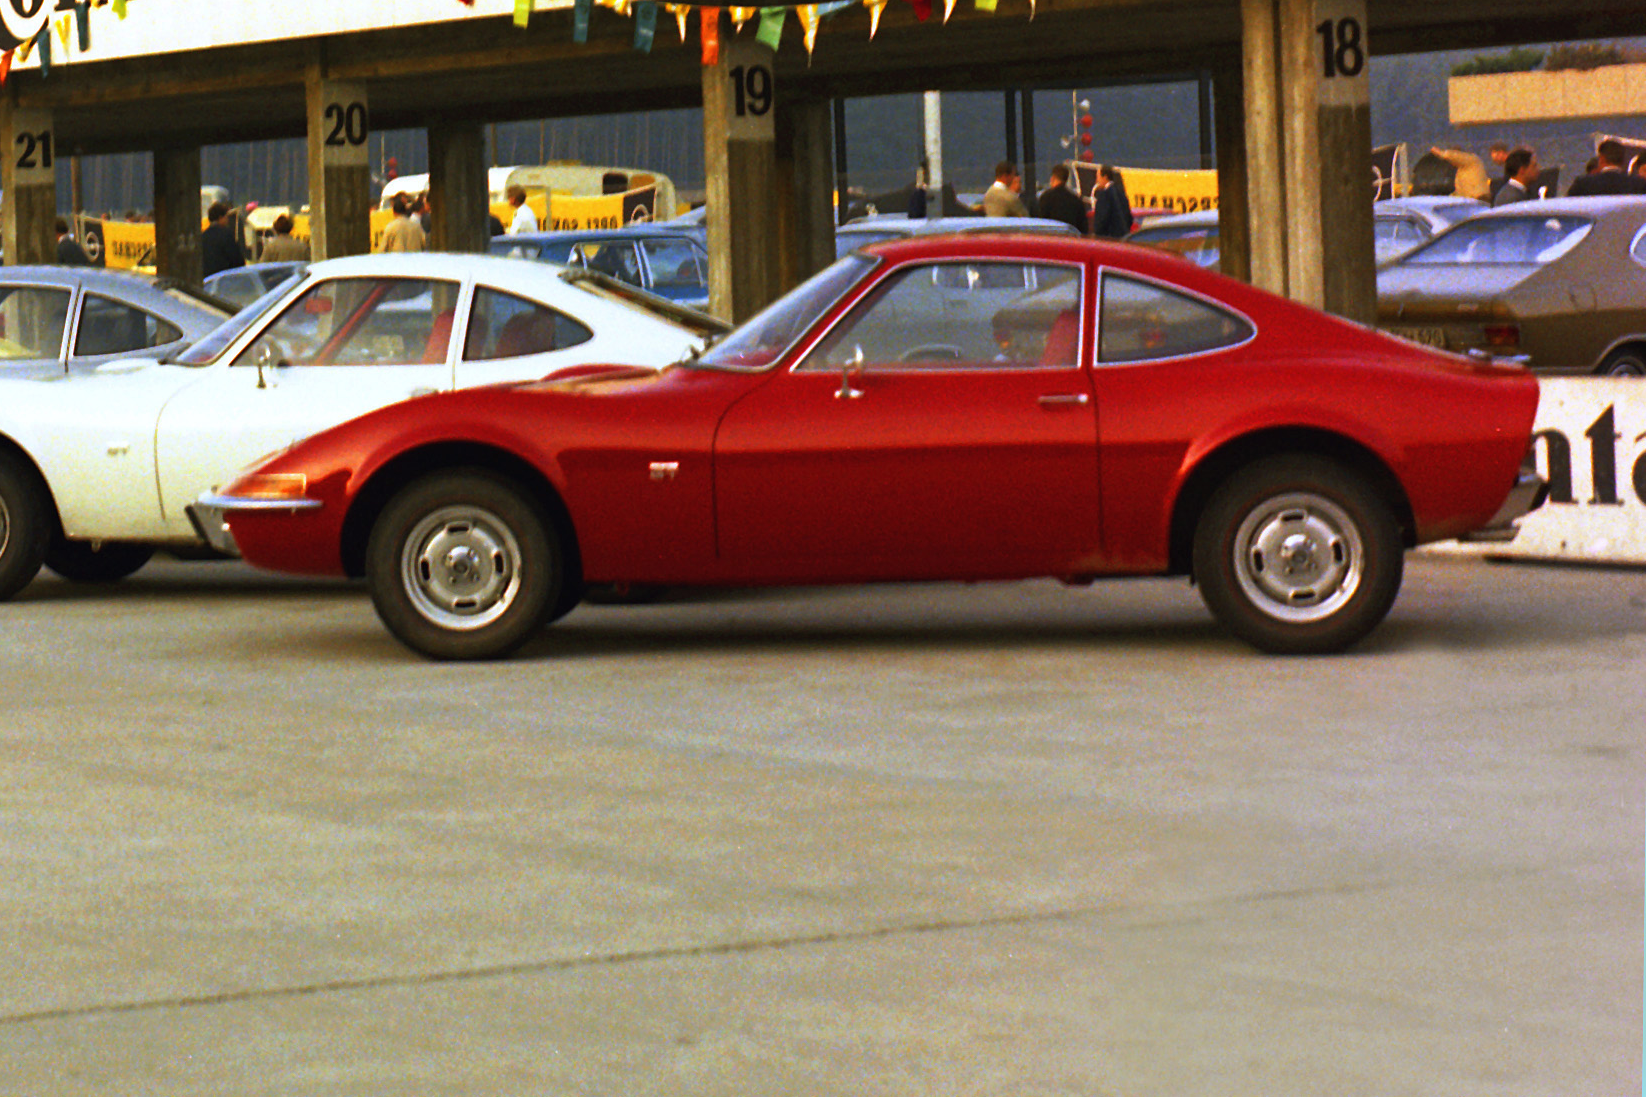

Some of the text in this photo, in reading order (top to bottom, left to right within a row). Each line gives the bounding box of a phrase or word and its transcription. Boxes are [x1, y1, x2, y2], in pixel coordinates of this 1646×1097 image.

[1316, 16, 1364, 79] 18
[729, 65, 772, 116] 19
[16, 130, 52, 168] 21
[325, 102, 368, 146] 20
[1530, 402, 1646, 507] nt
